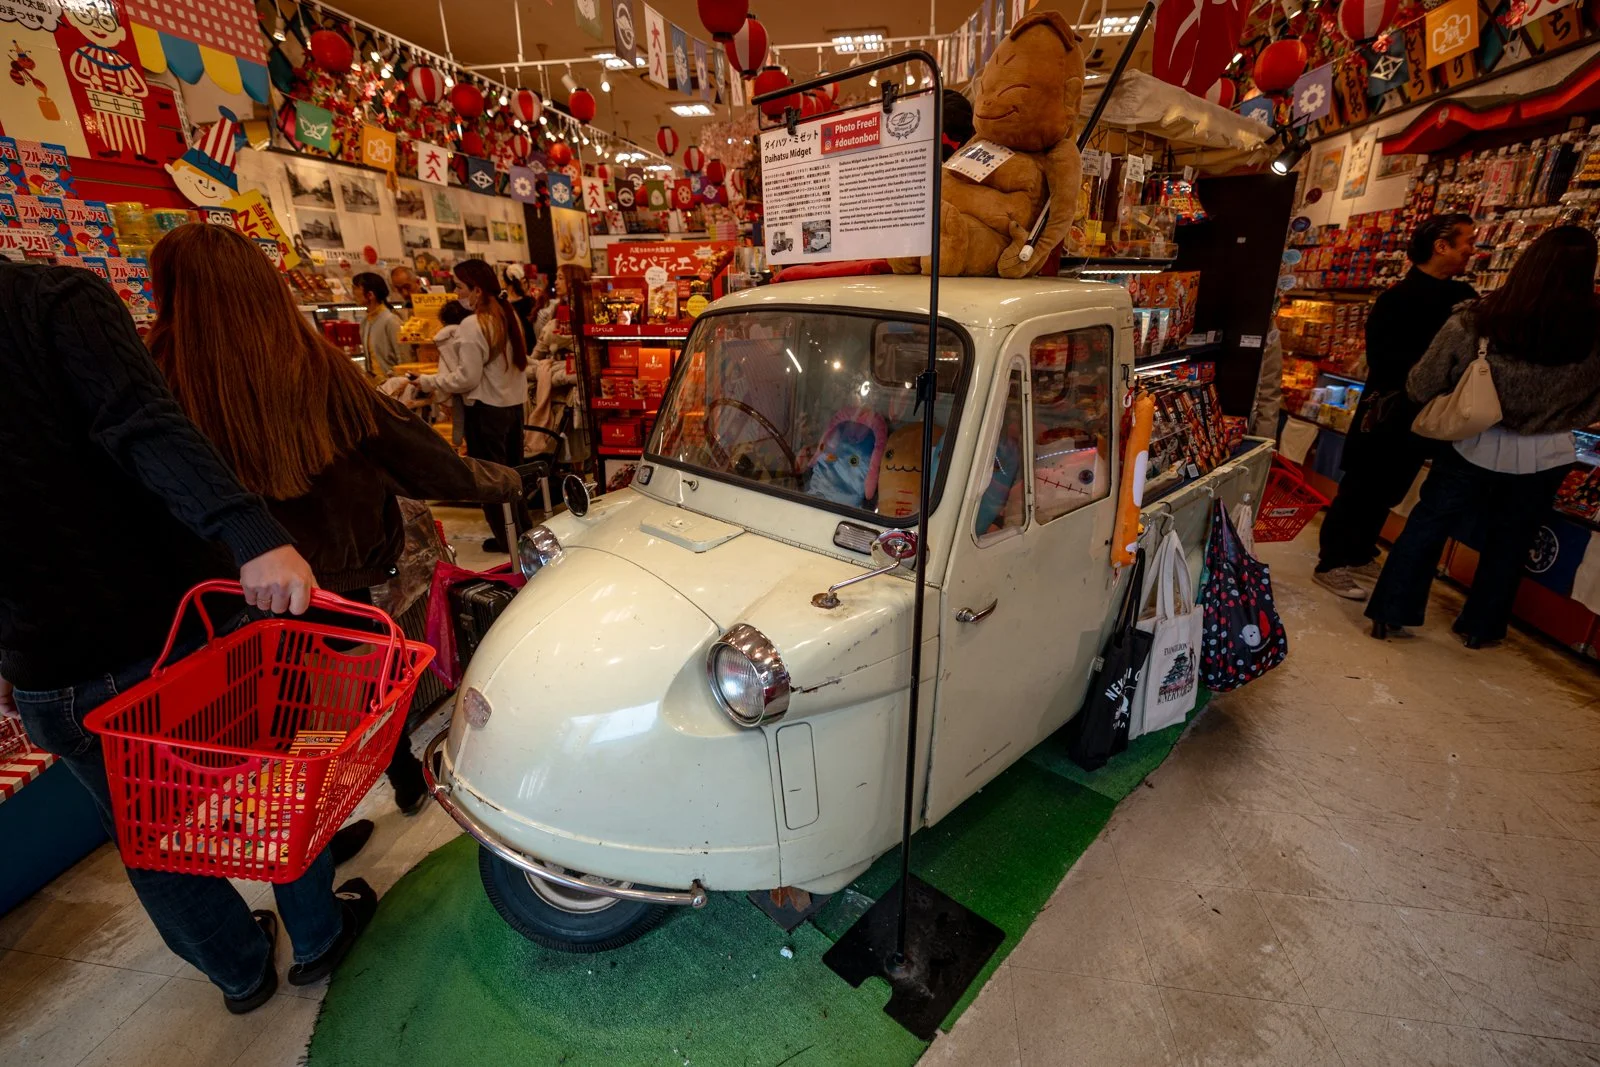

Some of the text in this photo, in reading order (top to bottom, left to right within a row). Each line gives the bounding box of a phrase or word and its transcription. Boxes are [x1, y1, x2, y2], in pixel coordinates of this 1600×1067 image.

[650, 21, 665, 80] 大入
[834, 116, 878, 134] Photo Free!!
[834, 132, 879, 148] #doutonbori
[425, 150, 441, 182] 大入
[764, 147, 812, 164] Daihatsu Midget
[588, 182, 602, 208] 大入
[613, 252, 694, 276] たこパティエ
